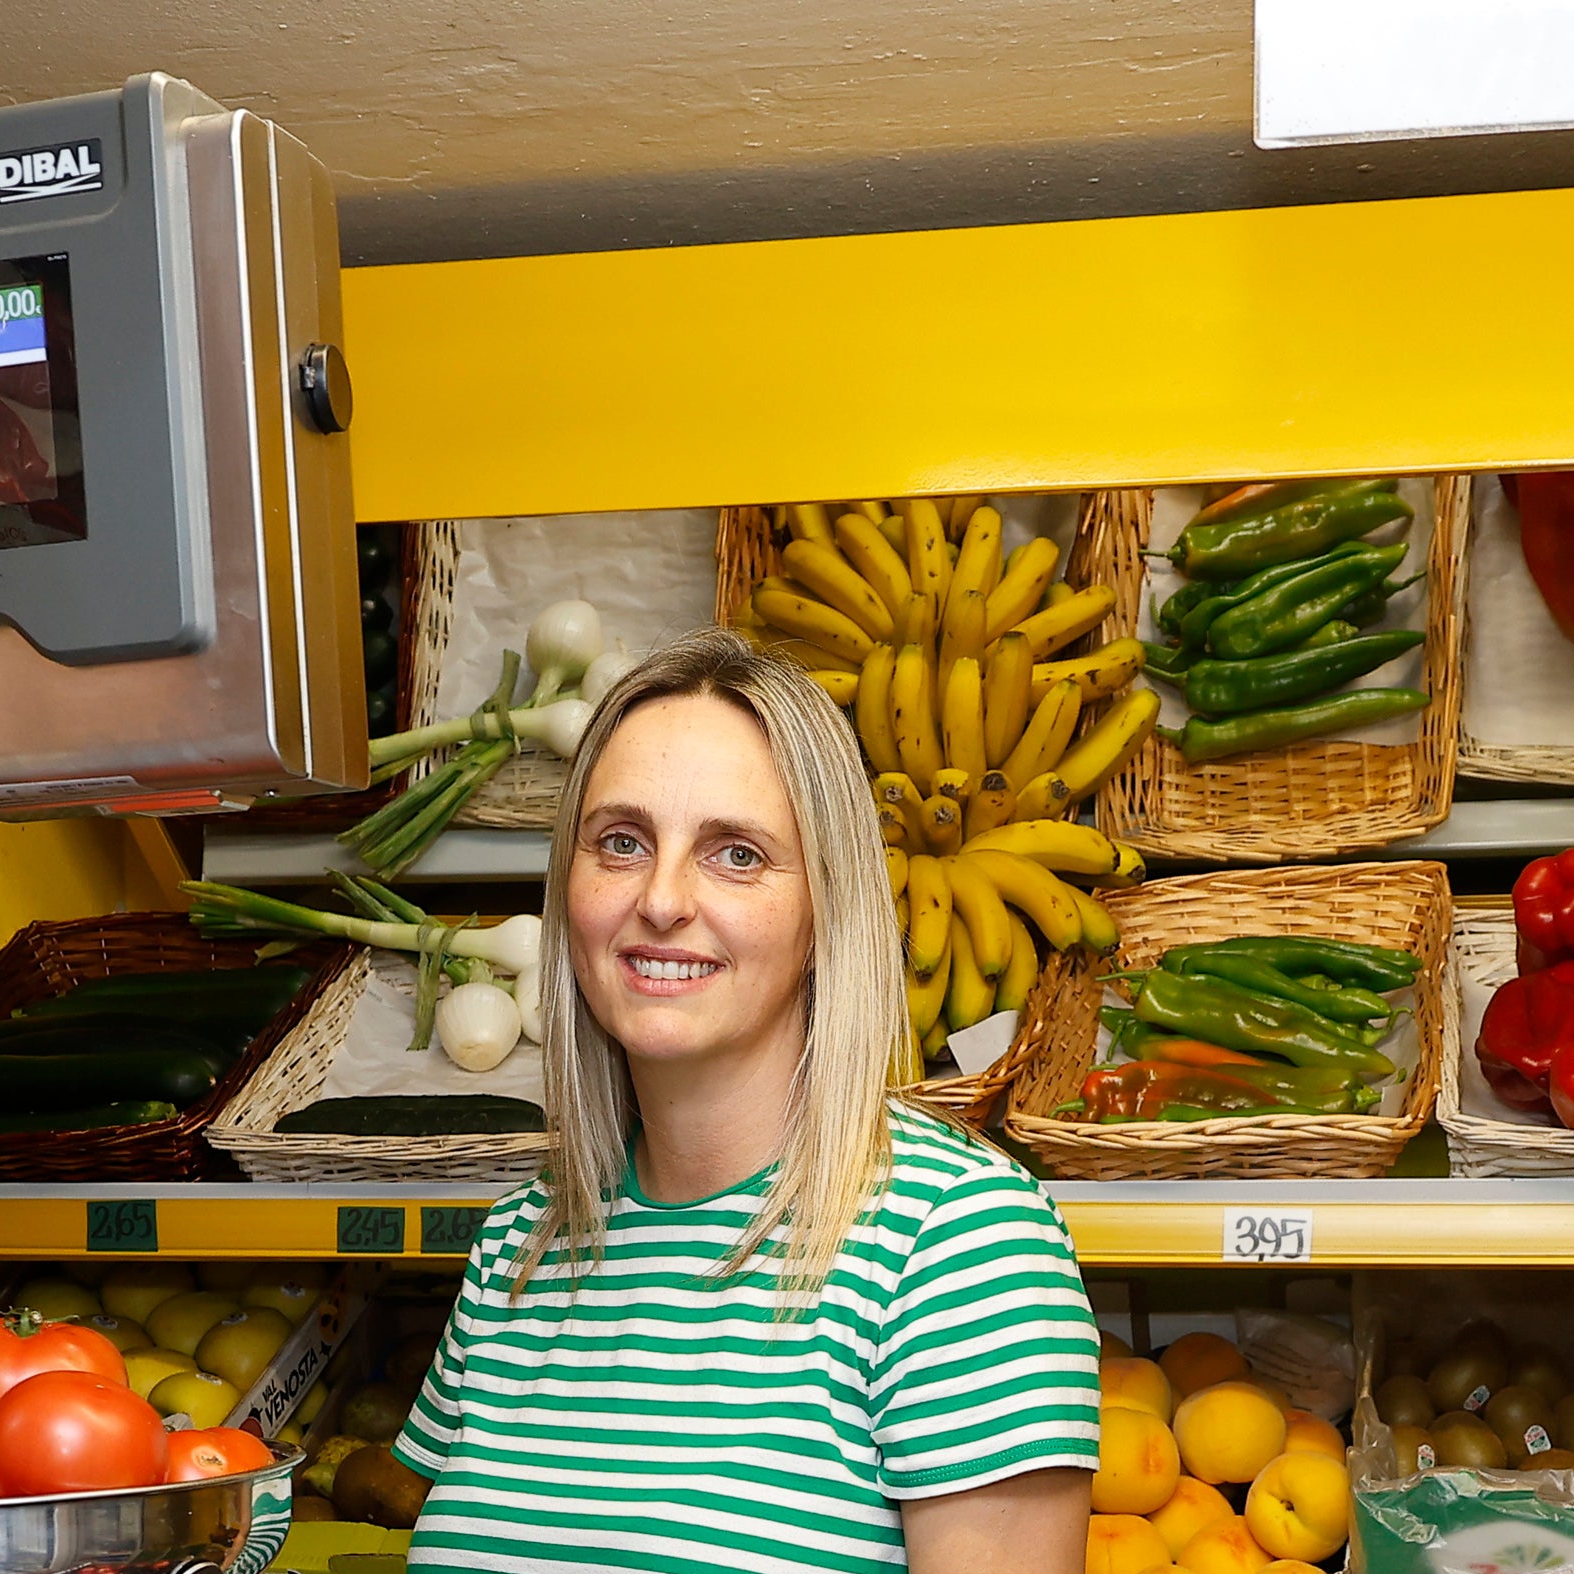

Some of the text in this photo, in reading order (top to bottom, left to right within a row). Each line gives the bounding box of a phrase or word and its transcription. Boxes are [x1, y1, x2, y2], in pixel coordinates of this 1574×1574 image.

[91, 1202, 156, 1242] 2,65
[262, 1378, 279, 1403] VAL
[264, 1348, 320, 1428] VENOSTA
